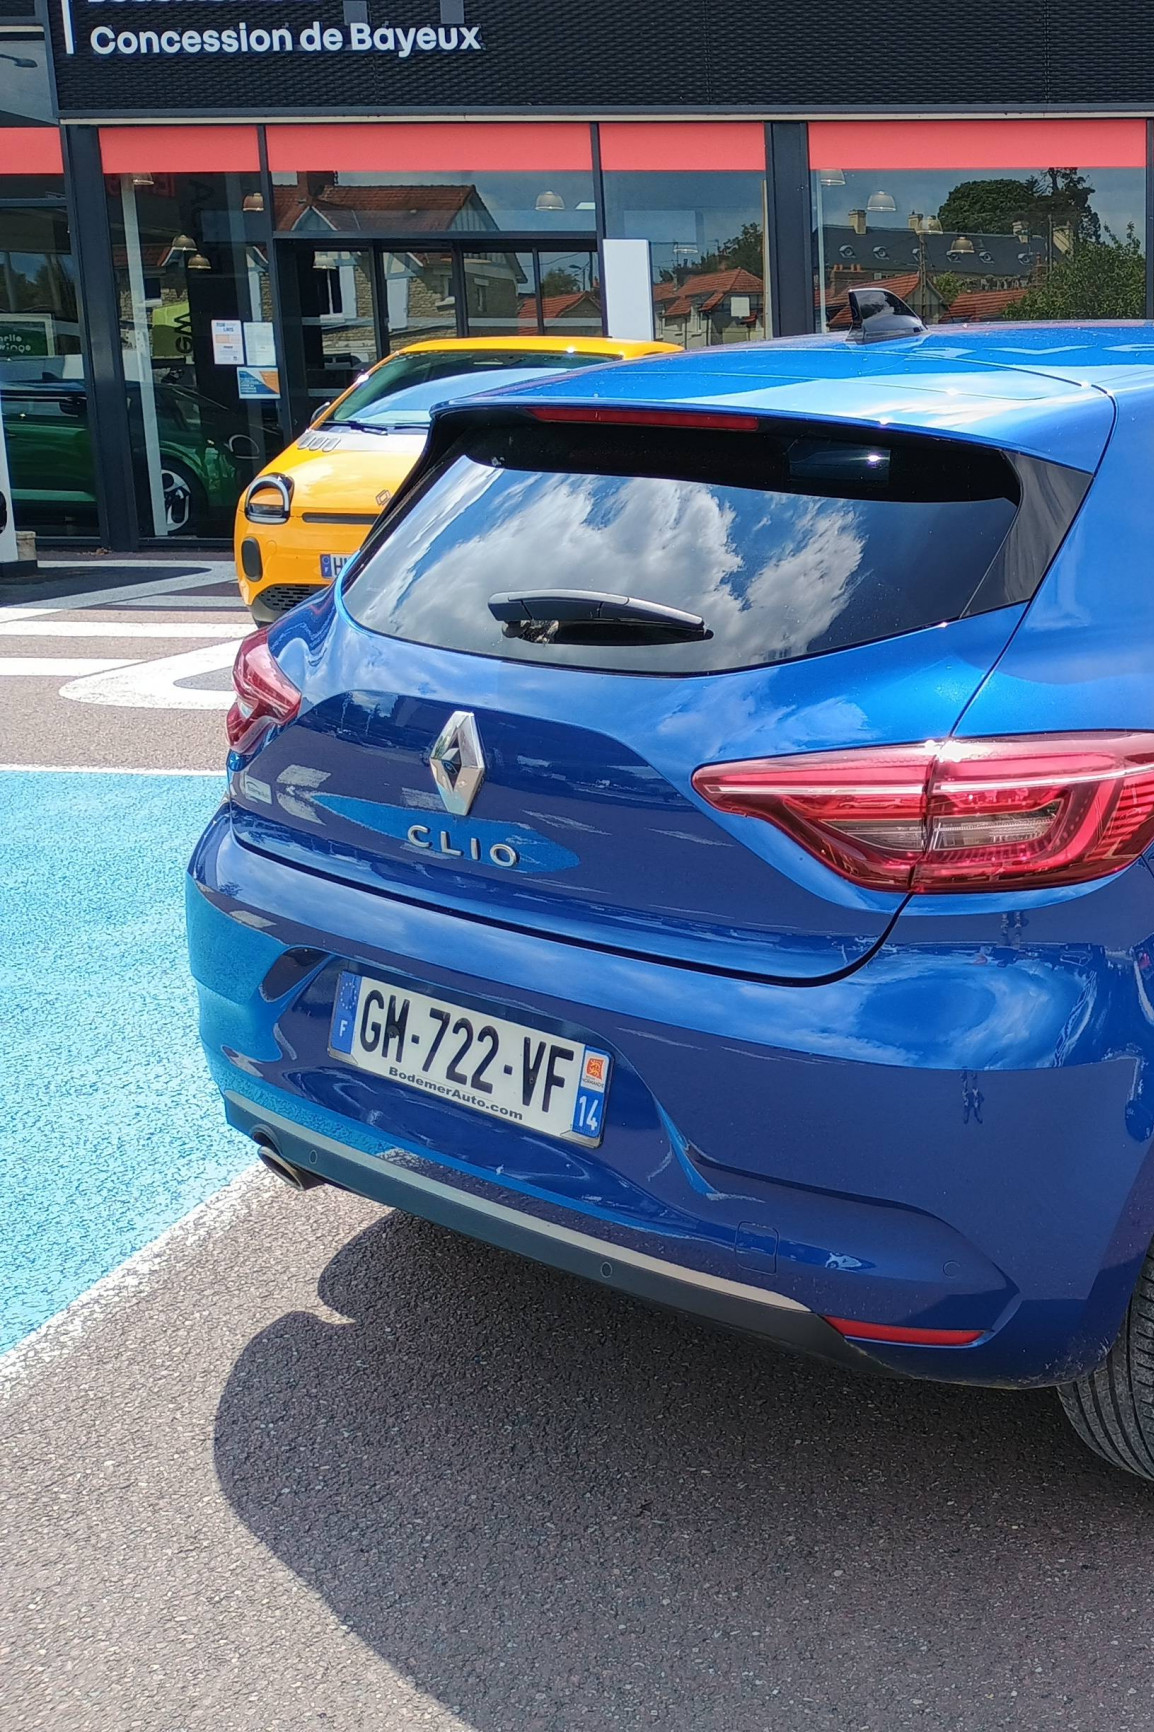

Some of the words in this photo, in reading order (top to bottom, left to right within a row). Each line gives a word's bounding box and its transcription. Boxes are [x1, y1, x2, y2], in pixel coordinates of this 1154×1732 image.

[90, 22, 293, 55] Concession
[300, 21, 343, 51] de
[350, 22, 482, 58] Bayeux
[407, 824, 517, 867] CLIO
[339, 1020, 348, 1037] F
[359, 988, 575, 1113] GM-722-VF
[388, 1065, 523, 1122] BodemerAuto.com
[579, 1095, 599, 1131] 14
